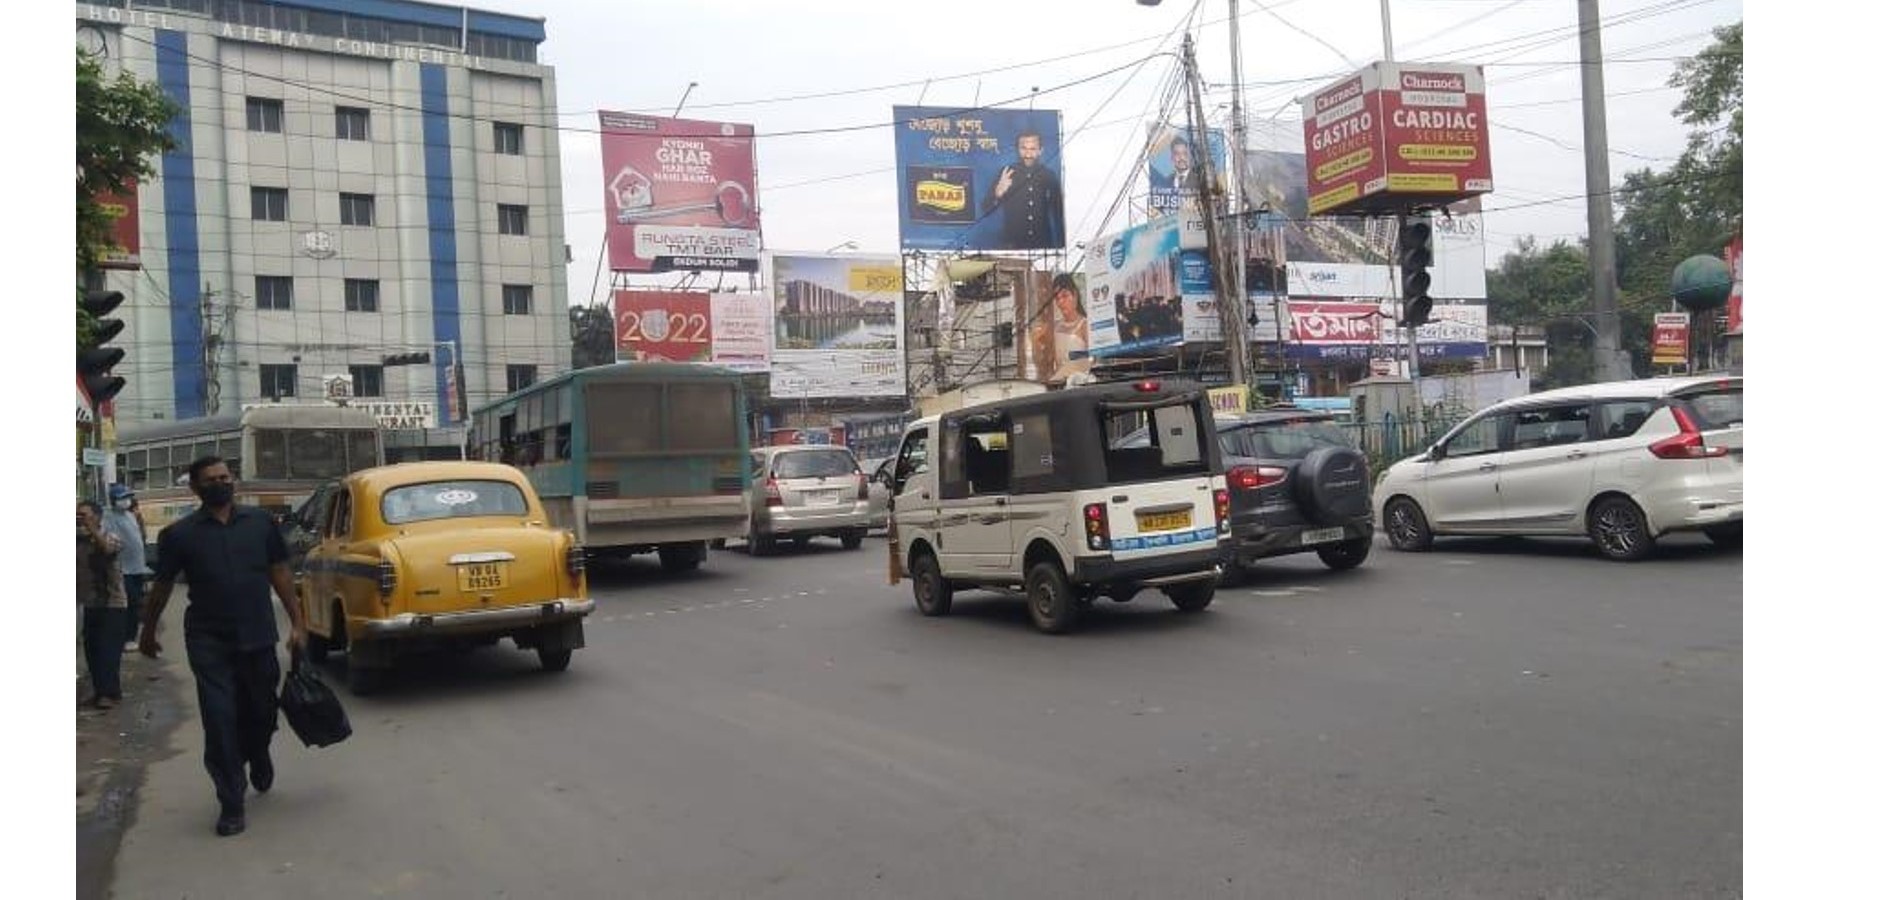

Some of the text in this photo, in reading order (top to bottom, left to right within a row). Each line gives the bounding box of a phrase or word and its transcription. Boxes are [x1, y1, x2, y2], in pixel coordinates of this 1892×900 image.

[90, 6, 173, 29] HOTEL
[336, 38, 486, 69] CONTINENTAL
[1402, 74, 1462, 89] Charnock
[1316, 82, 1362, 110] Charnock
[1393, 110, 1477, 129] CARDIAC
[1312, 112, 1372, 150] GASTRO
[1415, 130, 1479, 142] SCIENCES
[656, 149, 713, 165] GHAR
[642, 233, 755, 248] RUNGTA STEEL
[667, 244, 733, 255] TMT BAR
